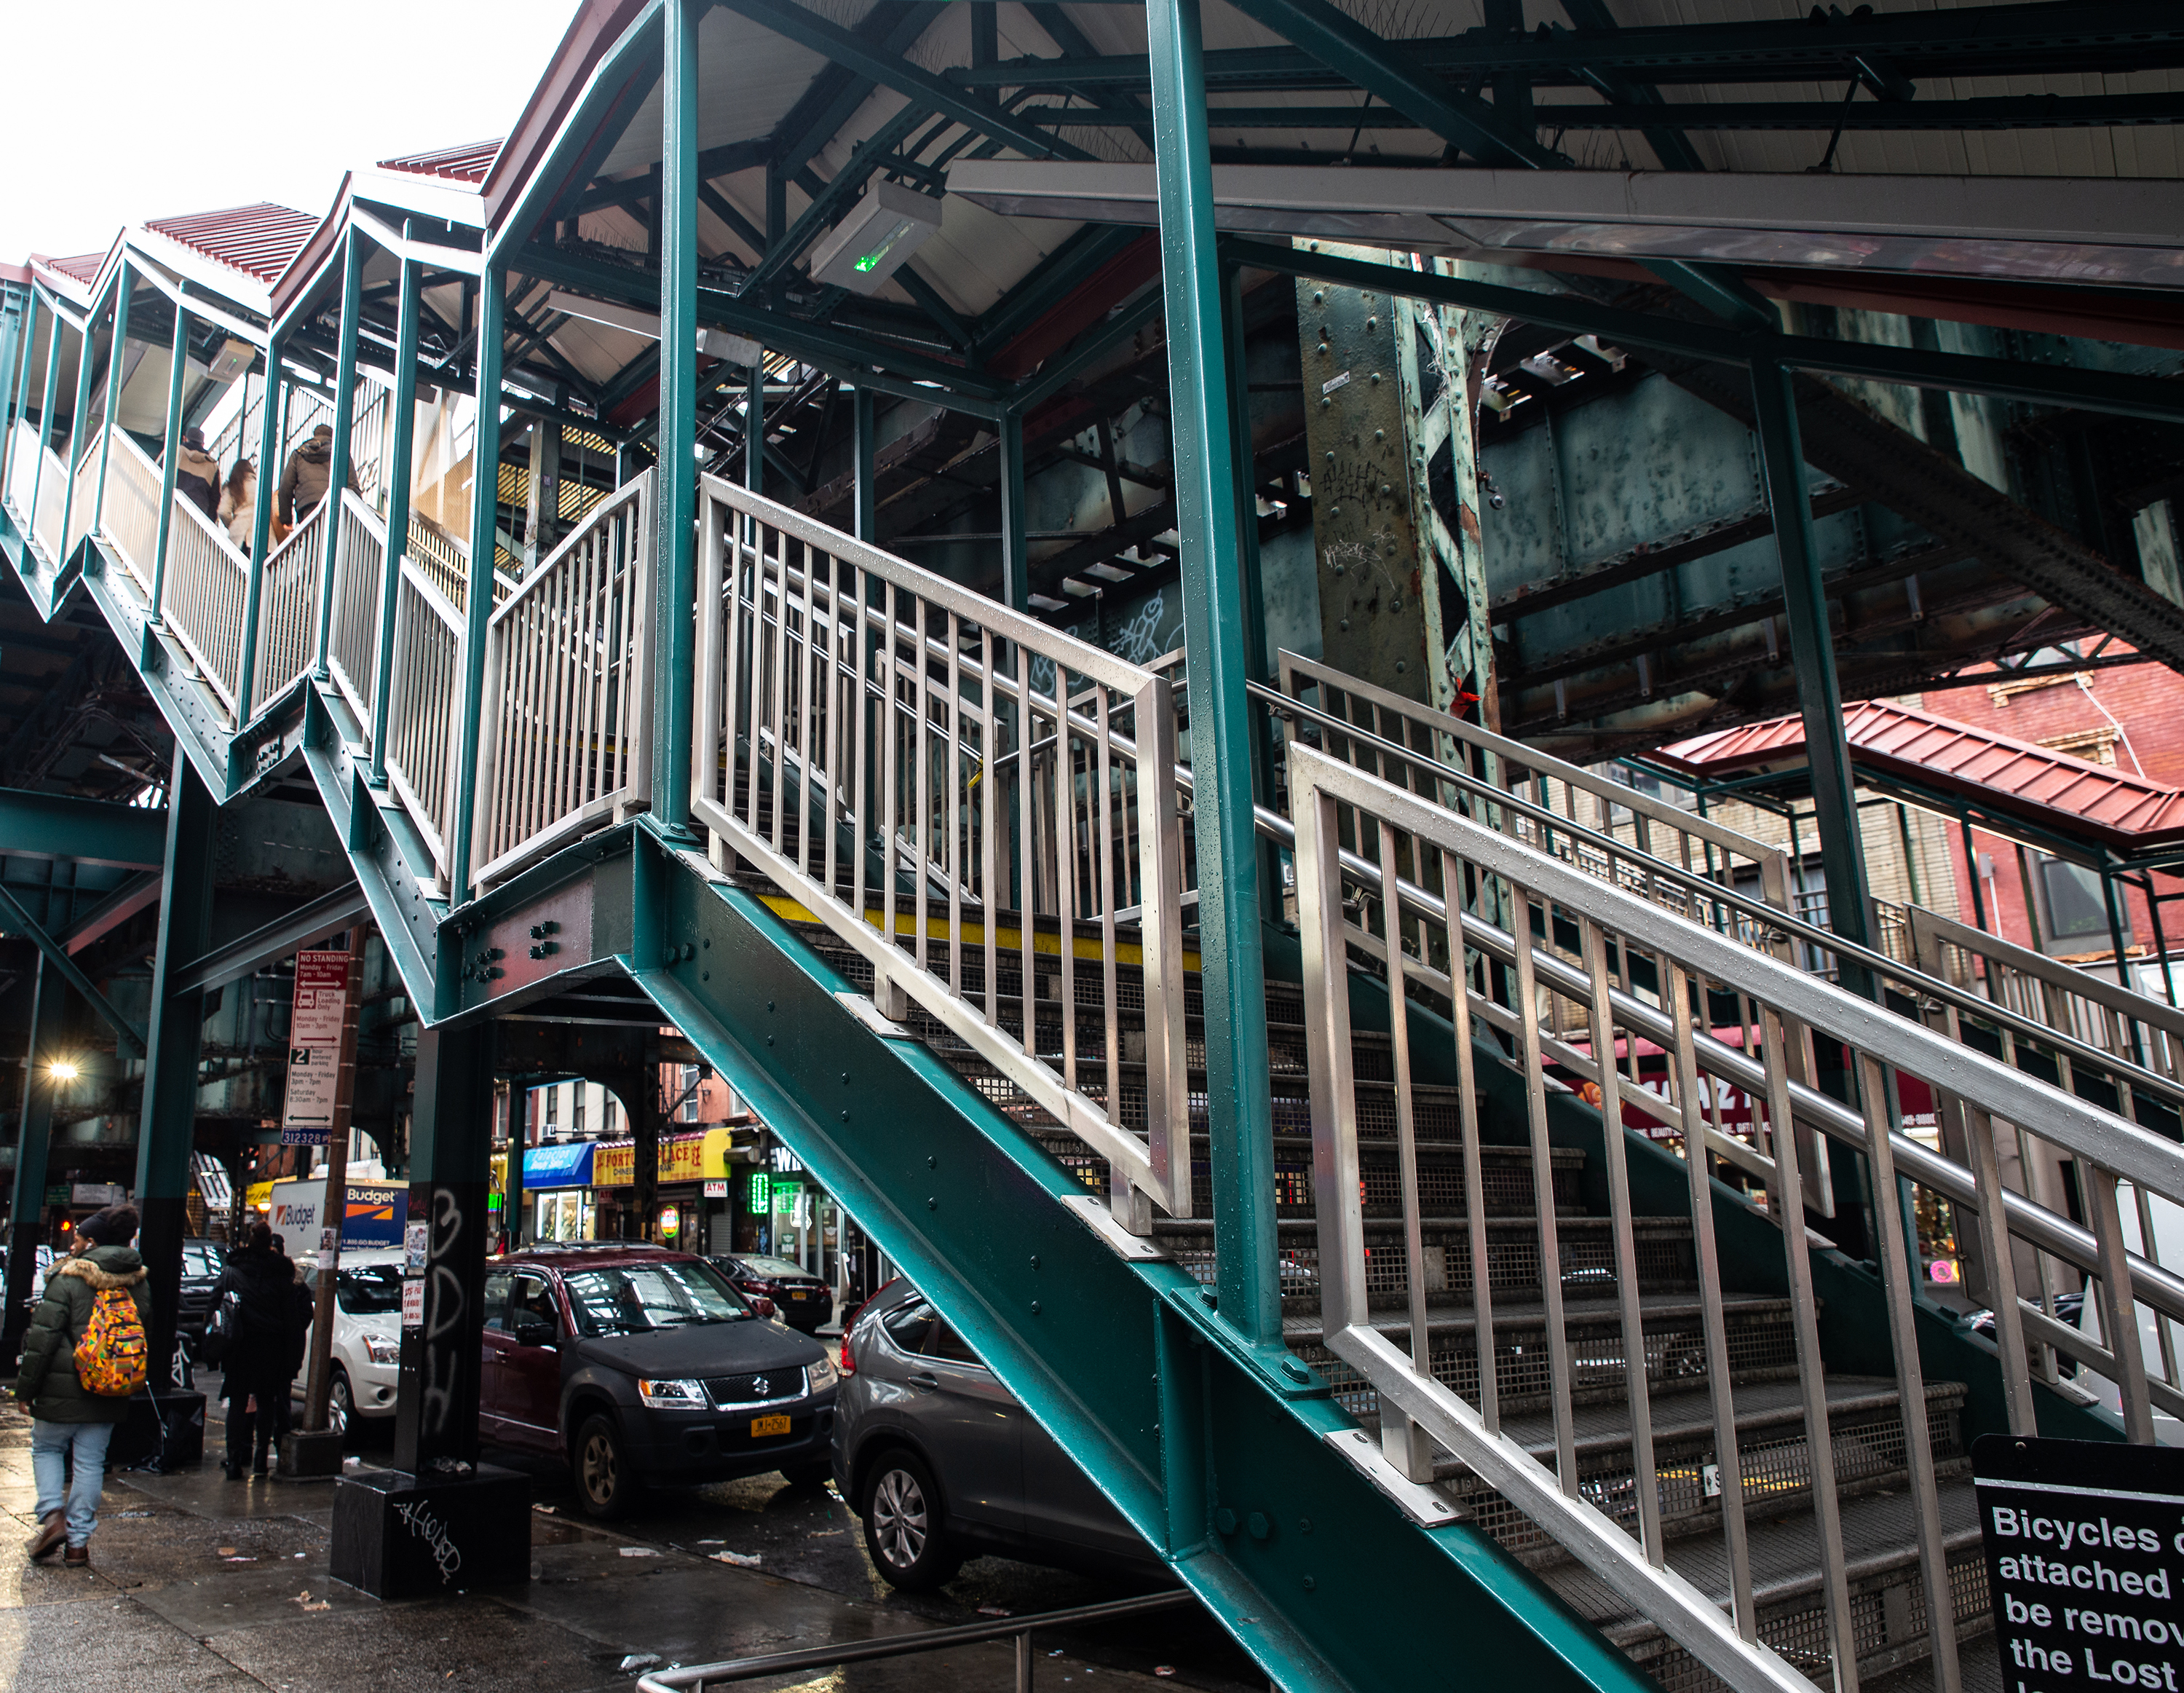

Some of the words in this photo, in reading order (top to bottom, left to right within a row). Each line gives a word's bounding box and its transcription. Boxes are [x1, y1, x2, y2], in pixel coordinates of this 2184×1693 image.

[313, 955, 349, 963] STANDING
[295, 1049, 306, 1063] 2
[284, 1132, 321, 1144] 312328
[347, 1188, 395, 1205] Budget
[706, 1183, 725, 1192] ATM
[285, 1204, 315, 1231] Budget
[1993, 1507, 2161, 1552] Bicycles
[2000, 1553, 2170, 1599] attached
[2004, 1593, 2052, 1627] be
[2010, 1638, 2073, 1675] the
[2084, 1647, 2178, 1692] Lost
